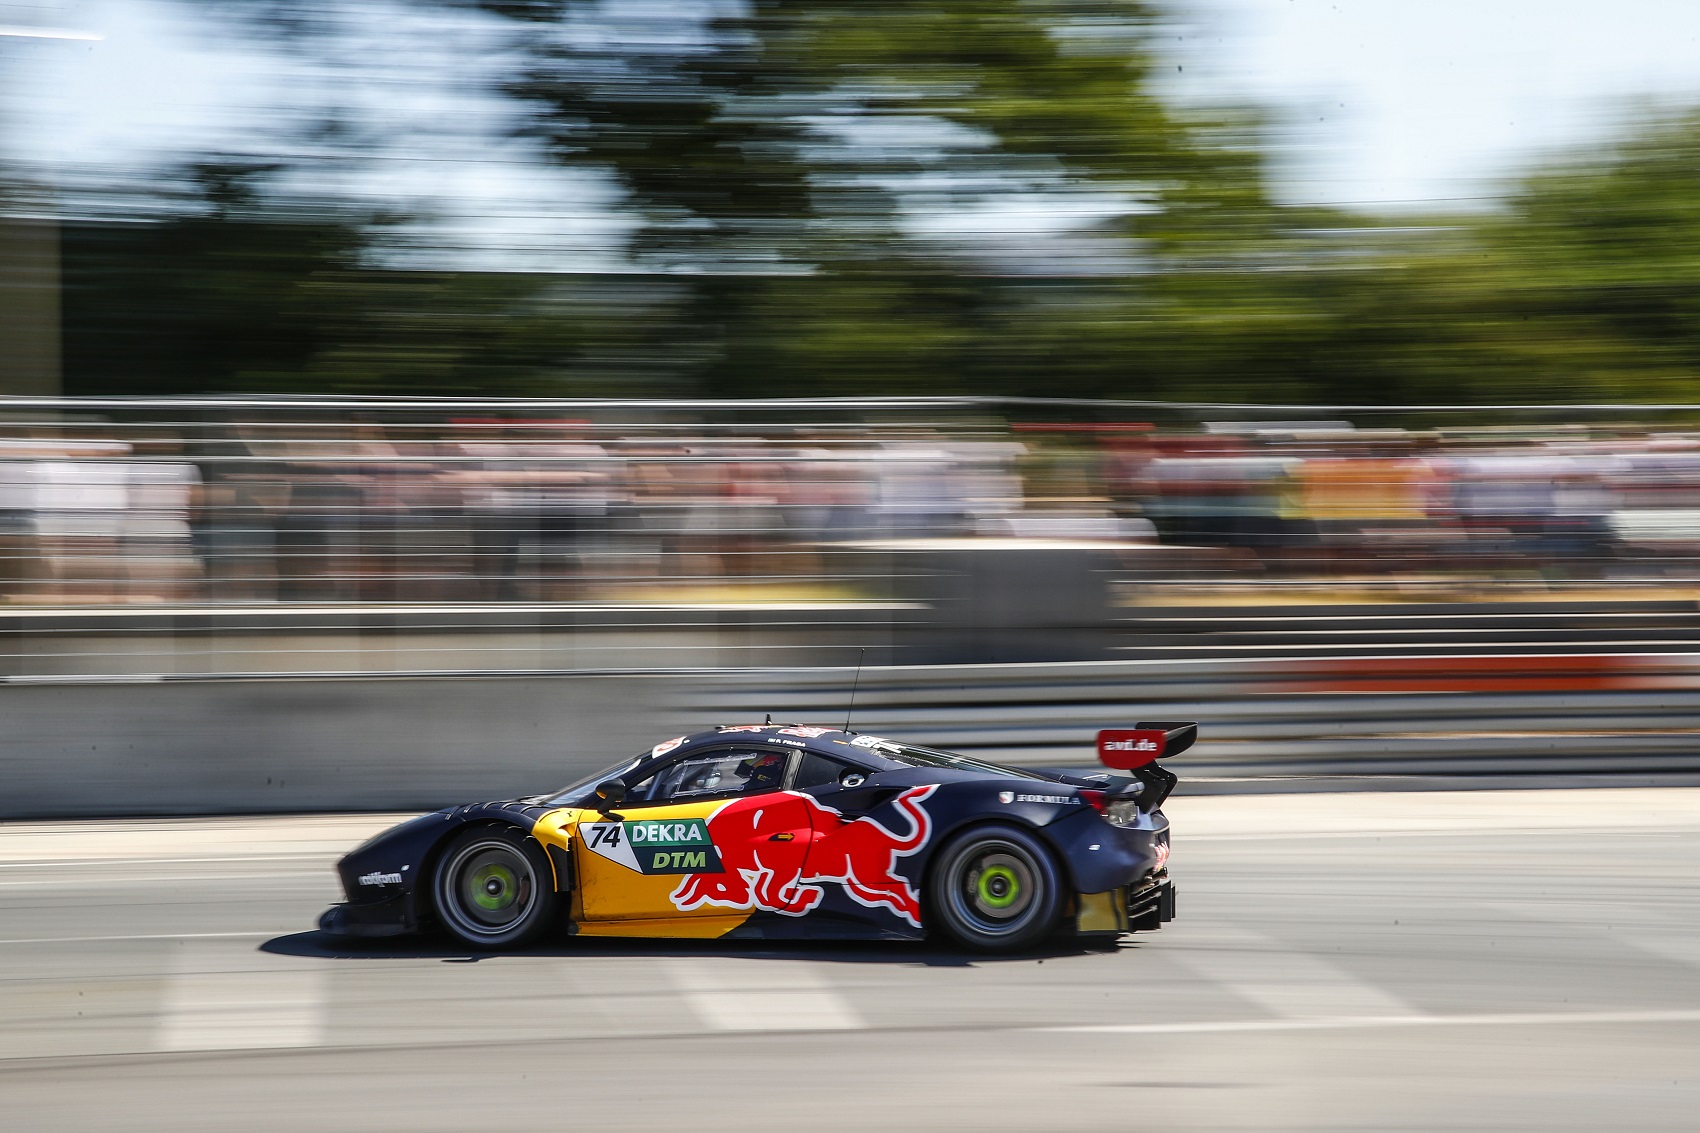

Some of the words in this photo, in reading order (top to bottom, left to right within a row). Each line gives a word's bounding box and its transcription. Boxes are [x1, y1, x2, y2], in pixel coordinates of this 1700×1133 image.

[1016, 794, 1081, 805] FORMULA
[590, 826, 621, 849] 74
[632, 823, 703, 843] DEKRA
[652, 851, 706, 869] DTM
